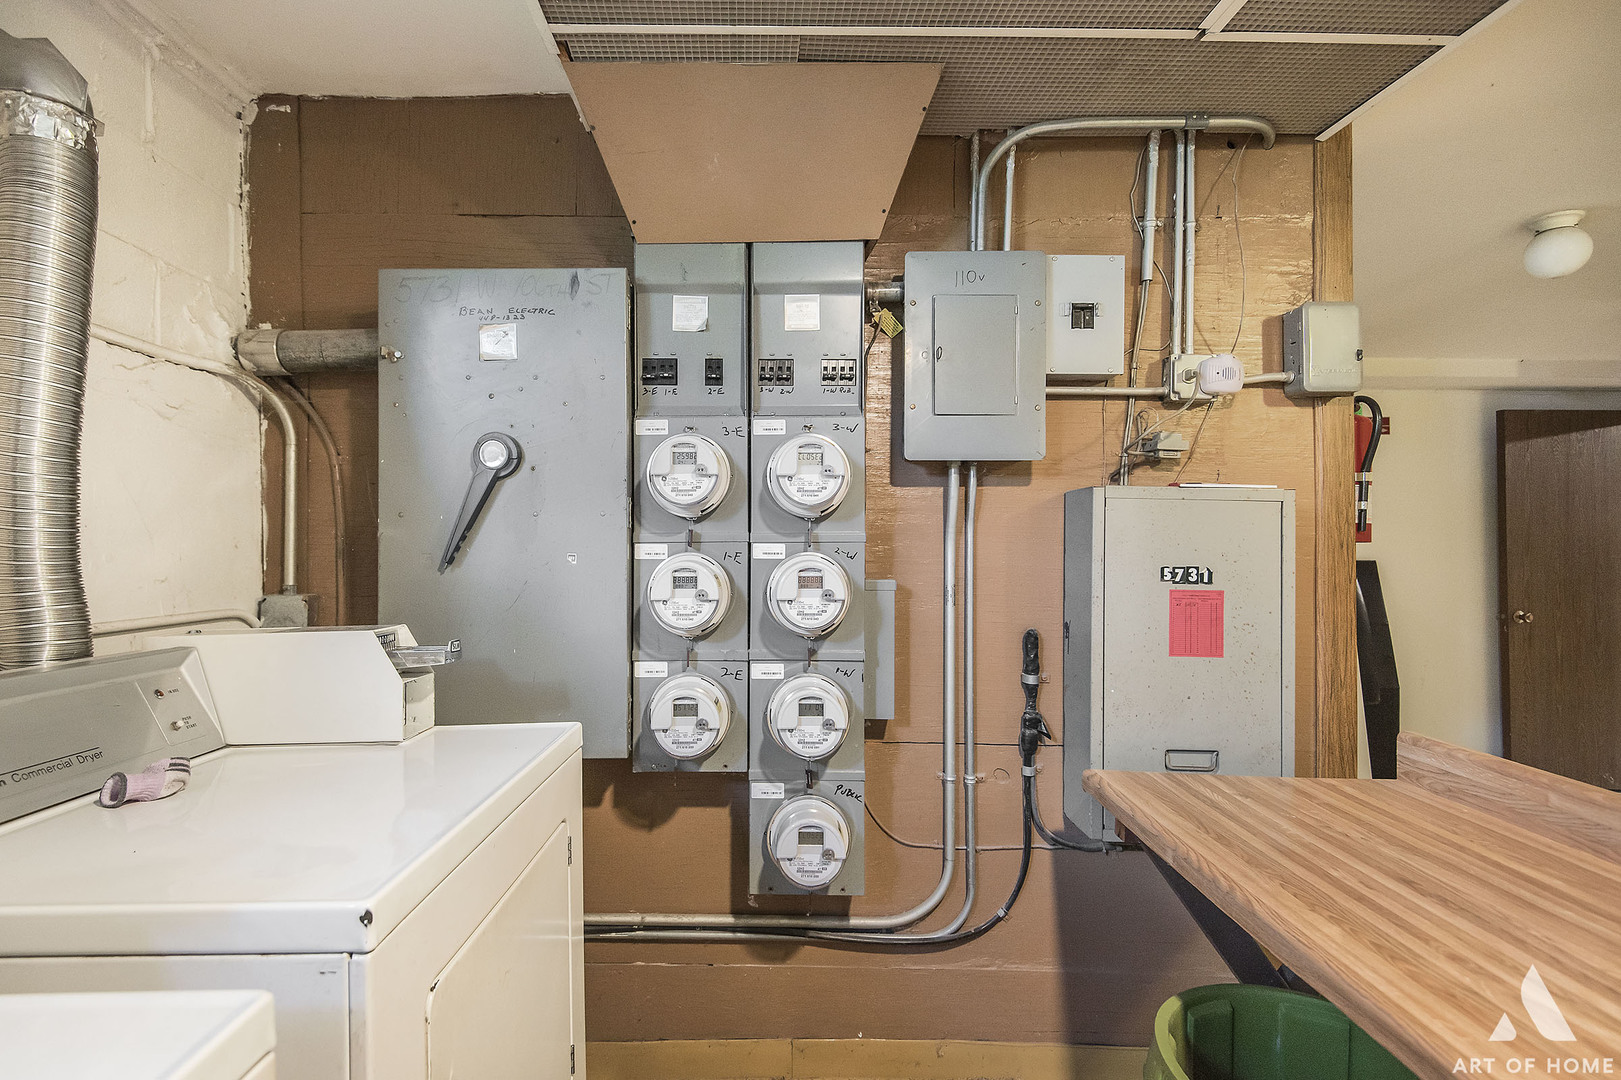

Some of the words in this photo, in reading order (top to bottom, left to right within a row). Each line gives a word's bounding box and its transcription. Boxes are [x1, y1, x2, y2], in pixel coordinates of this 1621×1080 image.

[459, 306, 493, 316] BEAN
[508, 307, 555, 316] ELECTRIC
[707, 387, 724, 395] 2-E
[721, 426, 745, 437] 3-E
[723, 551, 743, 565] 1-E
[834, 547, 858, 560] 2-W
[1162, 566, 1210, 583] 5731
[720, 667, 743, 681] 2-E
[11, 758, 74, 783] Commercial
[76, 751, 104, 765] Dryer
